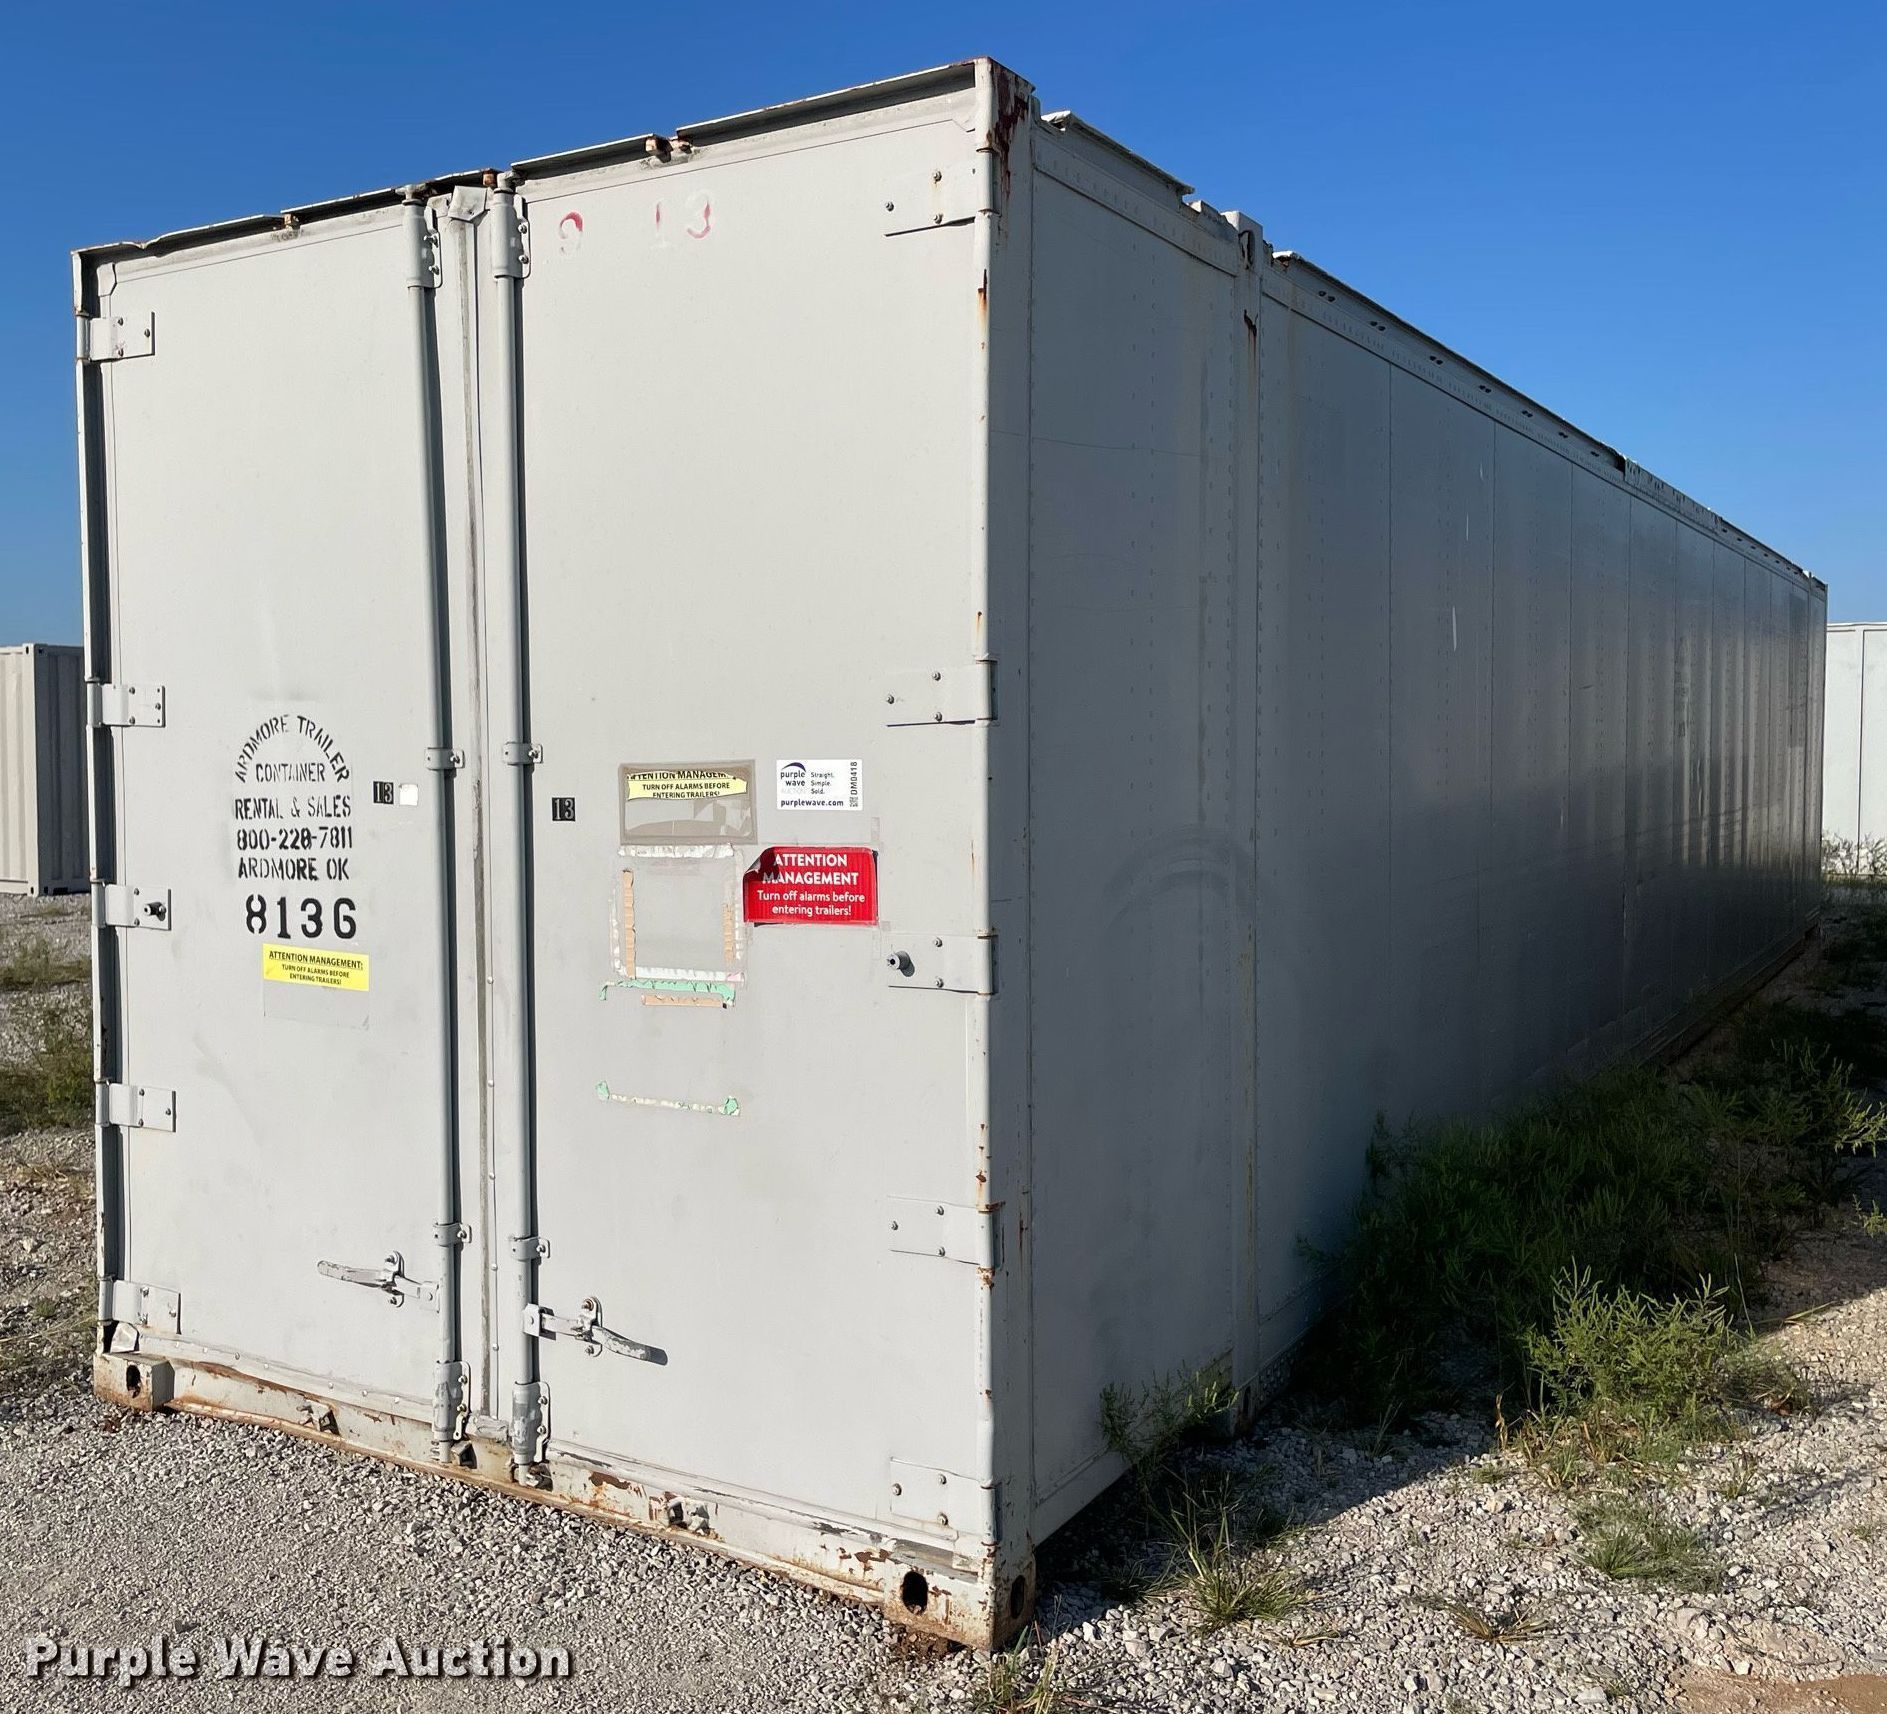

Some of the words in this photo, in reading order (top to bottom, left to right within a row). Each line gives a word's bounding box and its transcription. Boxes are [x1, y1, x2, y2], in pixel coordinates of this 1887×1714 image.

[234, 713, 289, 783] ARDMORE
[296, 715, 350, 783] TRAILER
[255, 762, 325, 782] CONTAINER
[780, 770, 806, 780] purple
[850, 761, 858, 795] DM0418
[374, 782, 393, 803] 13
[235, 797, 284, 820] RENTAL
[291, 796, 300, 818] &
[307, 794, 351, 818] SALES
[553, 798, 574, 820] 13
[780, 799, 844, 808] purplewave.com
[237, 825, 352, 851] 800-228-7811
[238, 857, 319, 881] ARDMORE
[326, 857, 349, 881] OK
[774, 853, 848, 867] ATTENTION
[762, 871, 859, 886] MANAGEMENT
[757, 890, 780, 901] Turn
[783, 890, 797, 901] off
[799, 891, 830, 902] alarms
[832, 891, 865, 903] before
[245, 894, 357, 939] 8136
[772, 905, 813, 917] entering
[815, 905, 852, 916] trailers!
[269, 950, 308, 962] ATTENTION
[309, 955, 363, 970] MANAGEMENT:
[282, 963, 295, 972] TURN
[296, 965, 306, 973] OFF
[307, 967, 329, 976] ALARMS
[329, 970, 349, 979] BEFORE
[289, 972, 315, 982] ENTERING
